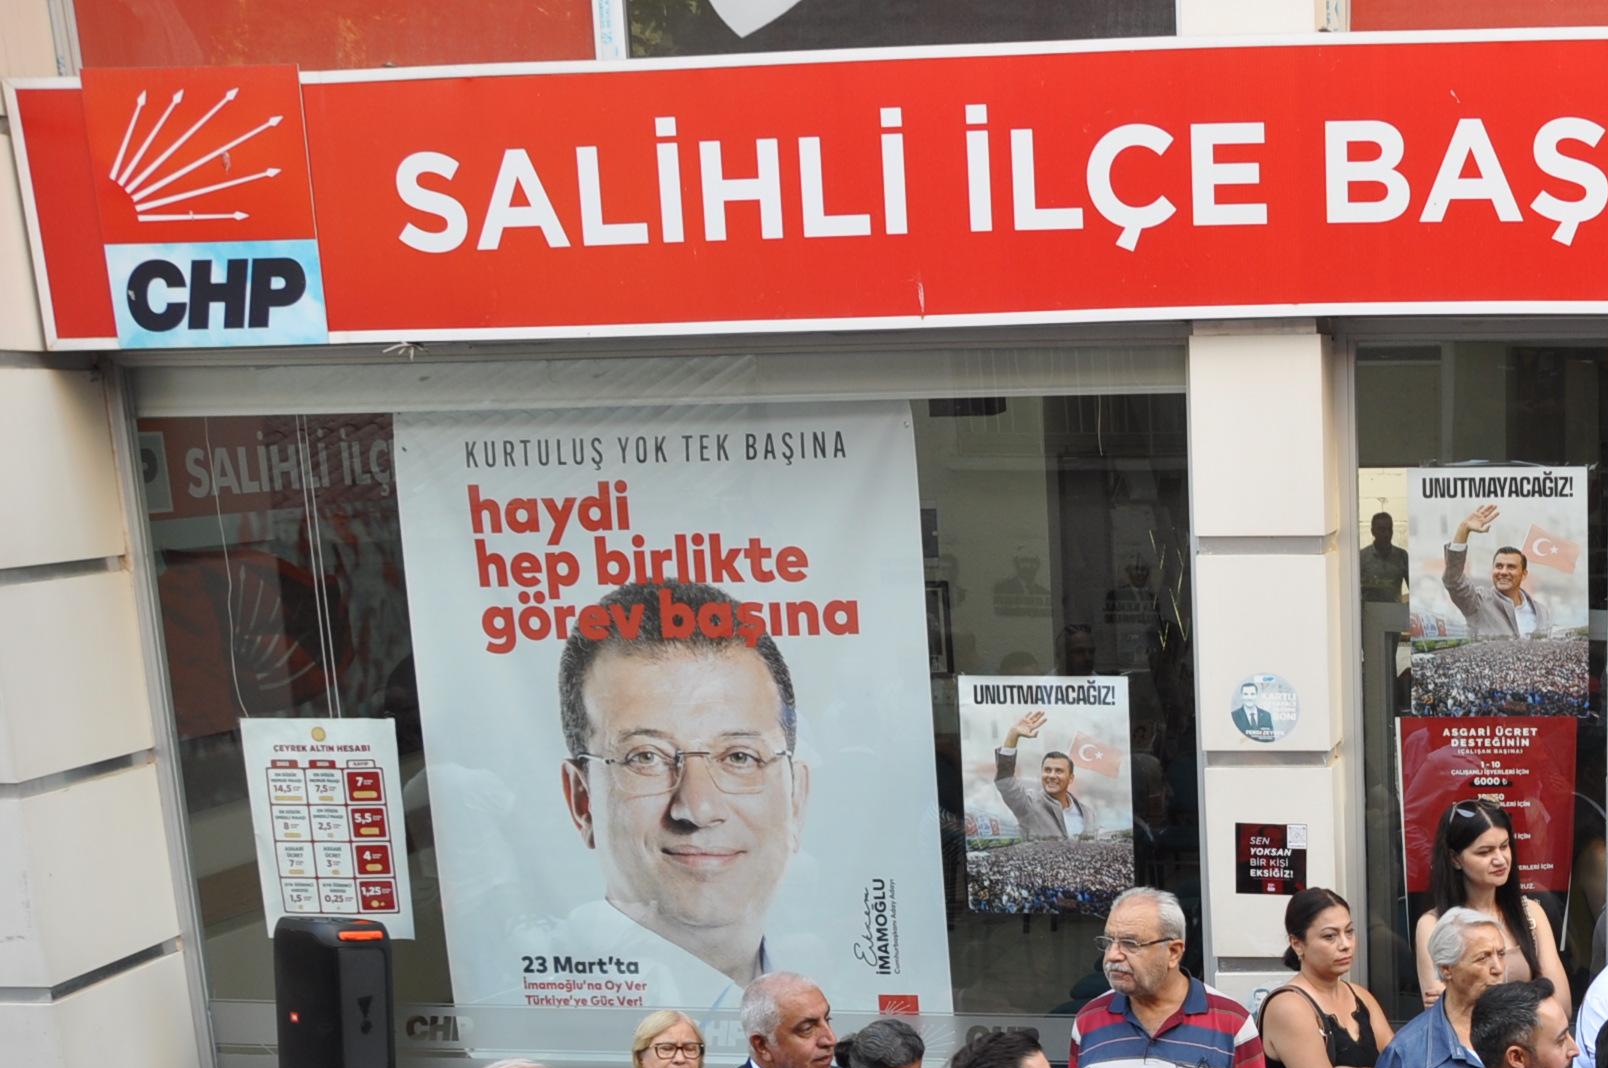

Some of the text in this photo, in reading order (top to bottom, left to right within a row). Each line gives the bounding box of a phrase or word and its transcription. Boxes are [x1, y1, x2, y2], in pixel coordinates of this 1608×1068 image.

[395, 106, 908, 254] SALİHLİ
[964, 103, 1268, 251] İLÇE
[127, 257, 307, 333] CHP
[465, 430, 848, 471] KURTULUŞ YOK TEK BAŞINA
[340, 427, 394, 495] İLÇ
[1421, 470, 1574, 499] UNUTMAYACAĞIZ!
[467, 480, 631, 545] haydi
[475, 533, 809, 600] hep birlikte
[481, 588, 860, 655] görev başına
[972, 679, 1117, 706] UNUTMAYACAĞIZ!
[1442, 725, 1539, 737] ASGARİ ÜCRET
[309, 744, 335, 753] ALTIN
[1450, 736, 1531, 748] DESTEĞİNİN
[1473, 776, 1500, 786] 6000
[1249, 836, 1271, 846] SEN
[1249, 847, 1293, 857] YOKSAN
[1249, 857, 1289, 868] BİR KİŞİ
[1249, 867, 1294, 878] EKSİĞİZ!
[871, 878, 891, 975] İMAMOĞLU
[521, 955, 640, 974] 23 Mart'ta
[522, 977, 648, 995] İmamoğlu'na Oy Ver
[524, 994, 586, 1009] Türkiye'ye
[616, 995, 644, 1007] Ver!
